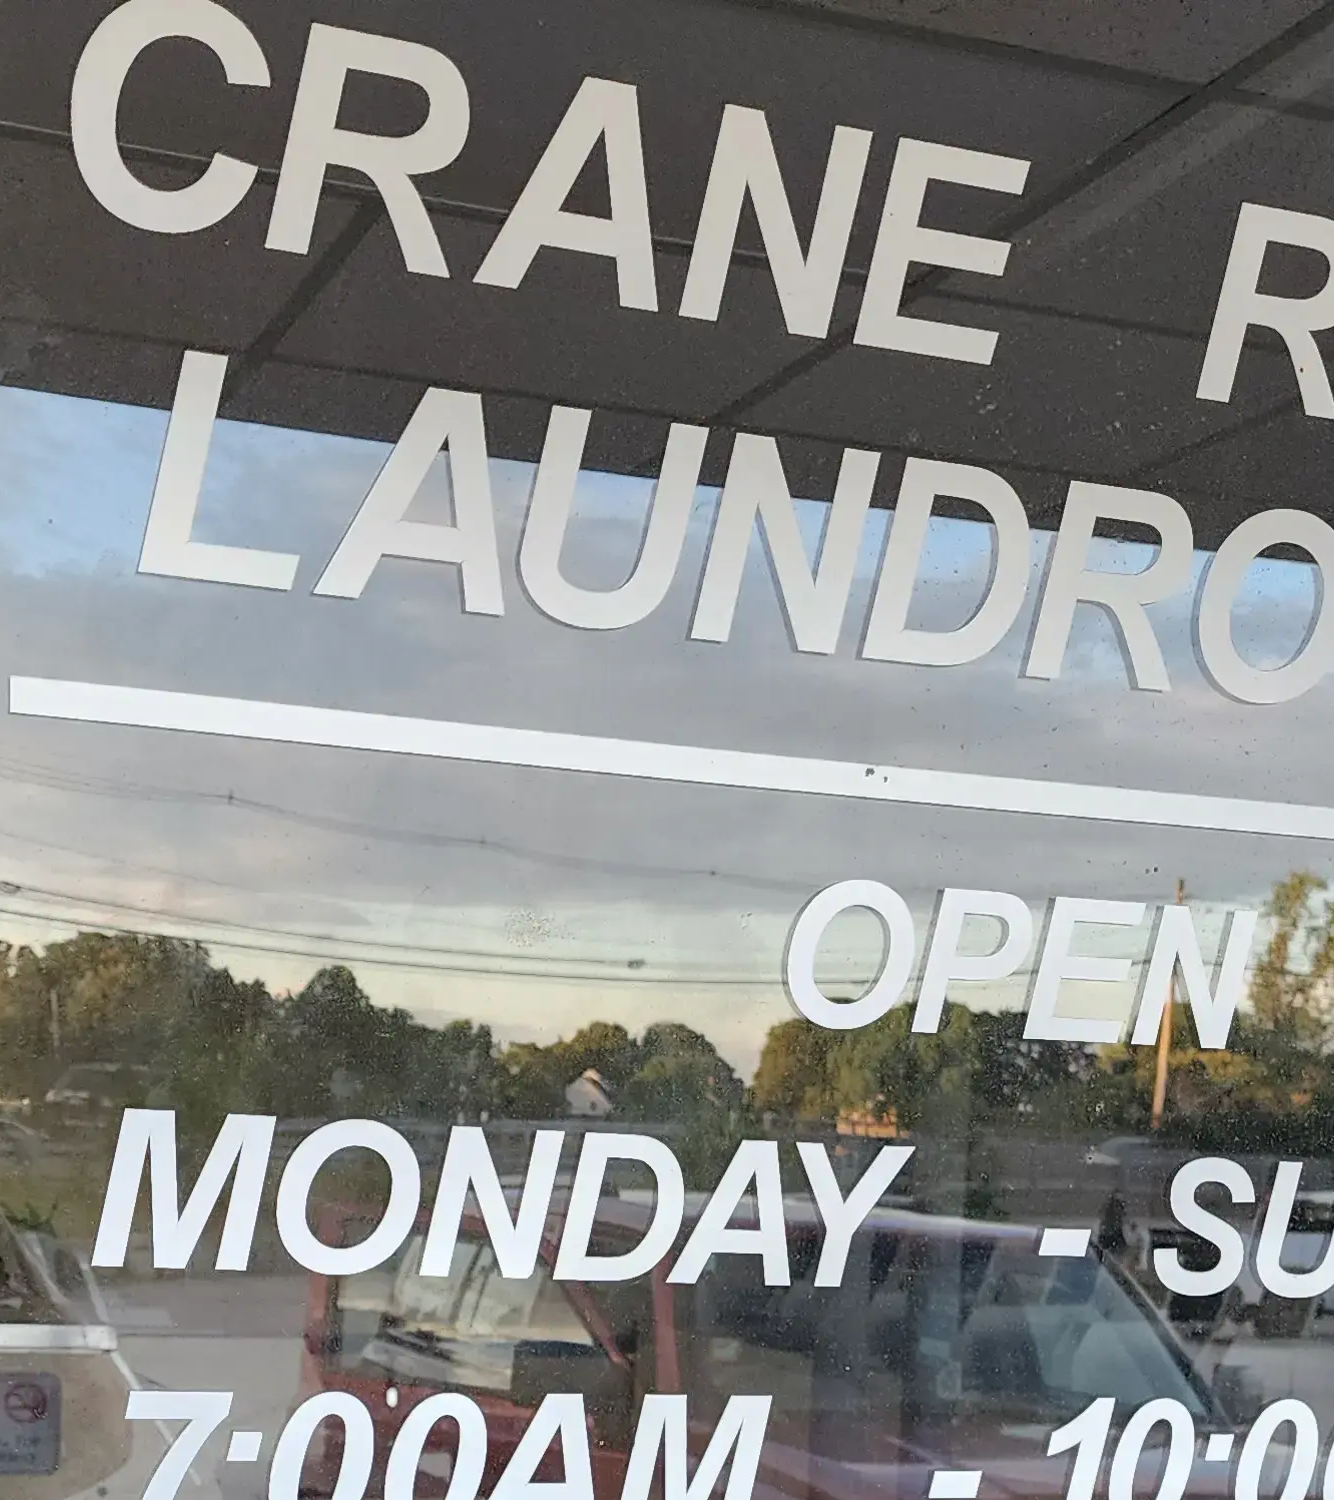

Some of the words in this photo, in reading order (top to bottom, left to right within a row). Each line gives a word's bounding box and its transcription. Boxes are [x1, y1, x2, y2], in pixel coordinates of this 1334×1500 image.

[70, 0, 1030, 365] CRANE
[785, 879, 1257, 1050] OPEN
[91, 1107, 916, 1288] MONDAY
[1037, 1229, 1093, 1258] -
[927, 1469, 983, 1500] -
